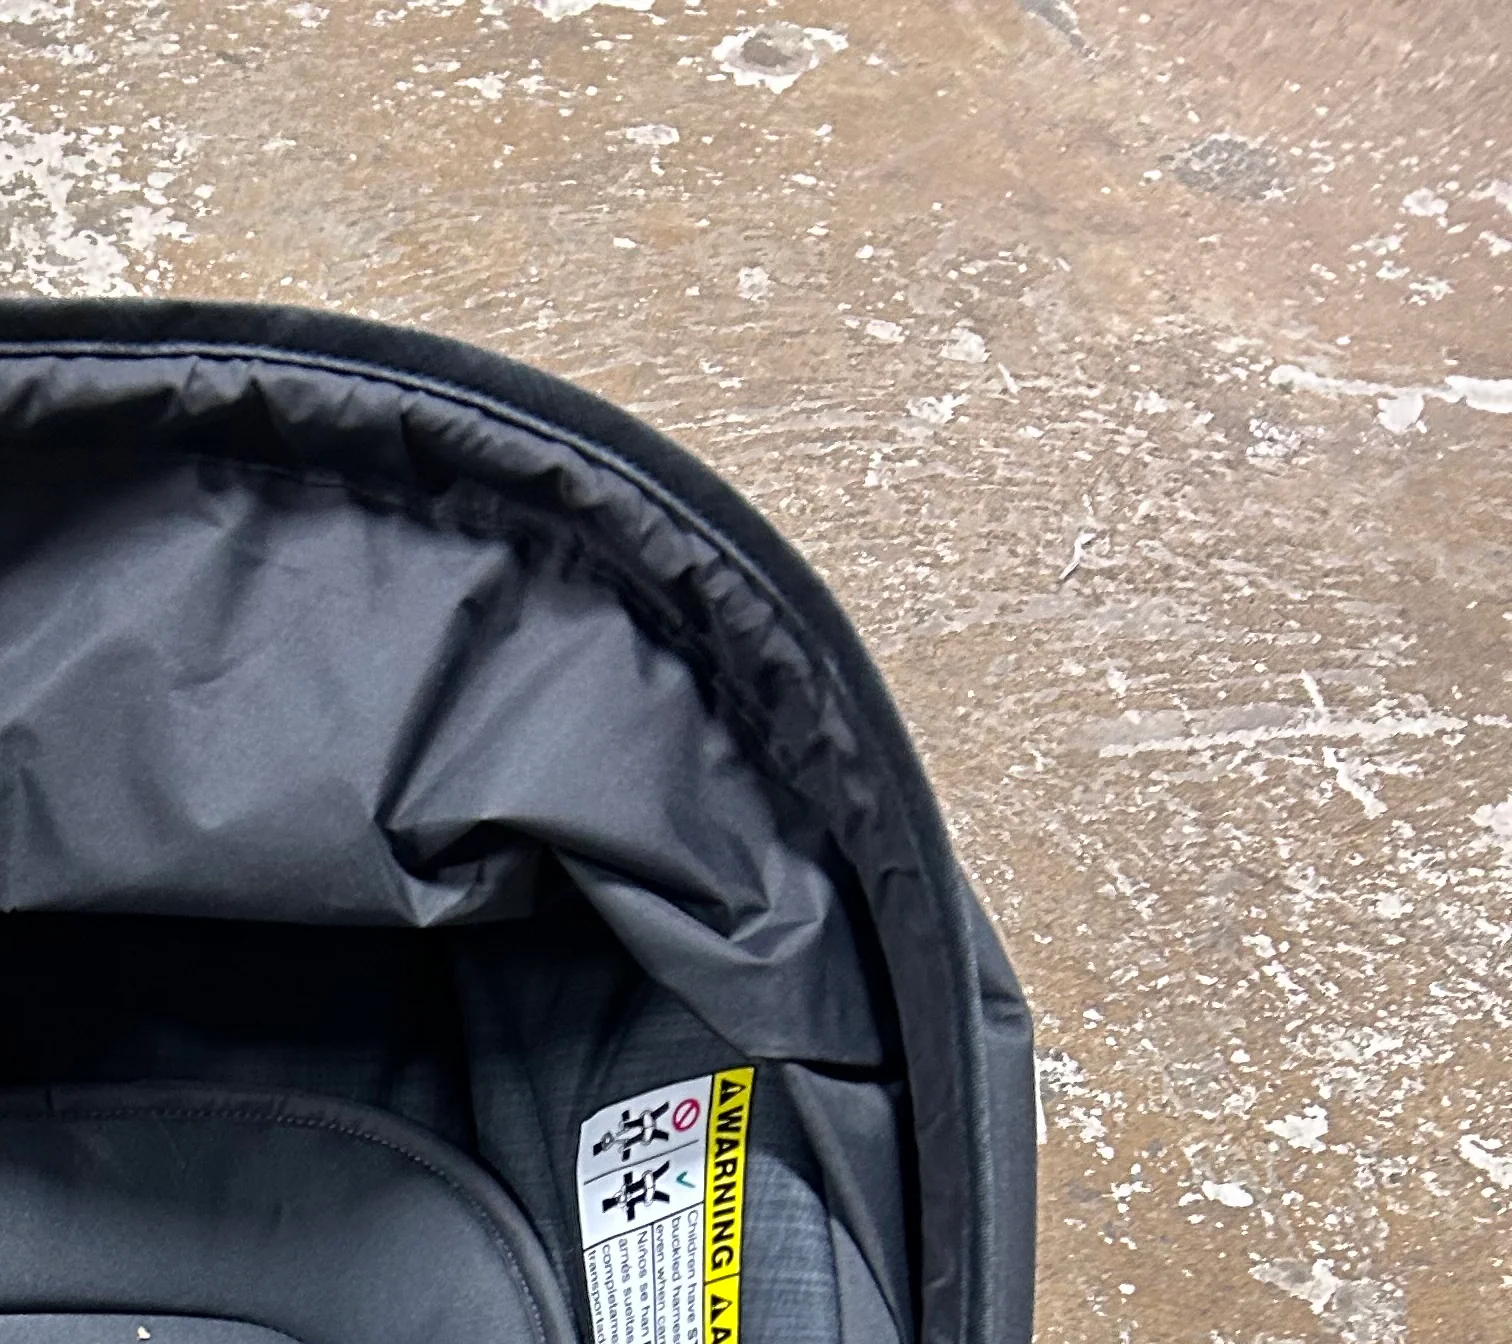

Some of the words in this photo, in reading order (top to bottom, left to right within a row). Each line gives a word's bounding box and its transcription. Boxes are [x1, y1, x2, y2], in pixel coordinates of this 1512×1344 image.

[711, 1104, 743, 1272] WARNING
[617, 1235, 632, 1284] arnés
[636, 1229, 649, 1279] Niños
[654, 1222, 665, 1263] even
[670, 1215, 682, 1283] buckled
[686, 1208, 698, 1280] Children
[639, 1281, 648, 1302] se
[655, 1264, 667, 1311] when
[686, 1281, 697, 1324] have
[622, 1285, 636, 1344] sueltas
[640, 1304, 651, 1337] han
